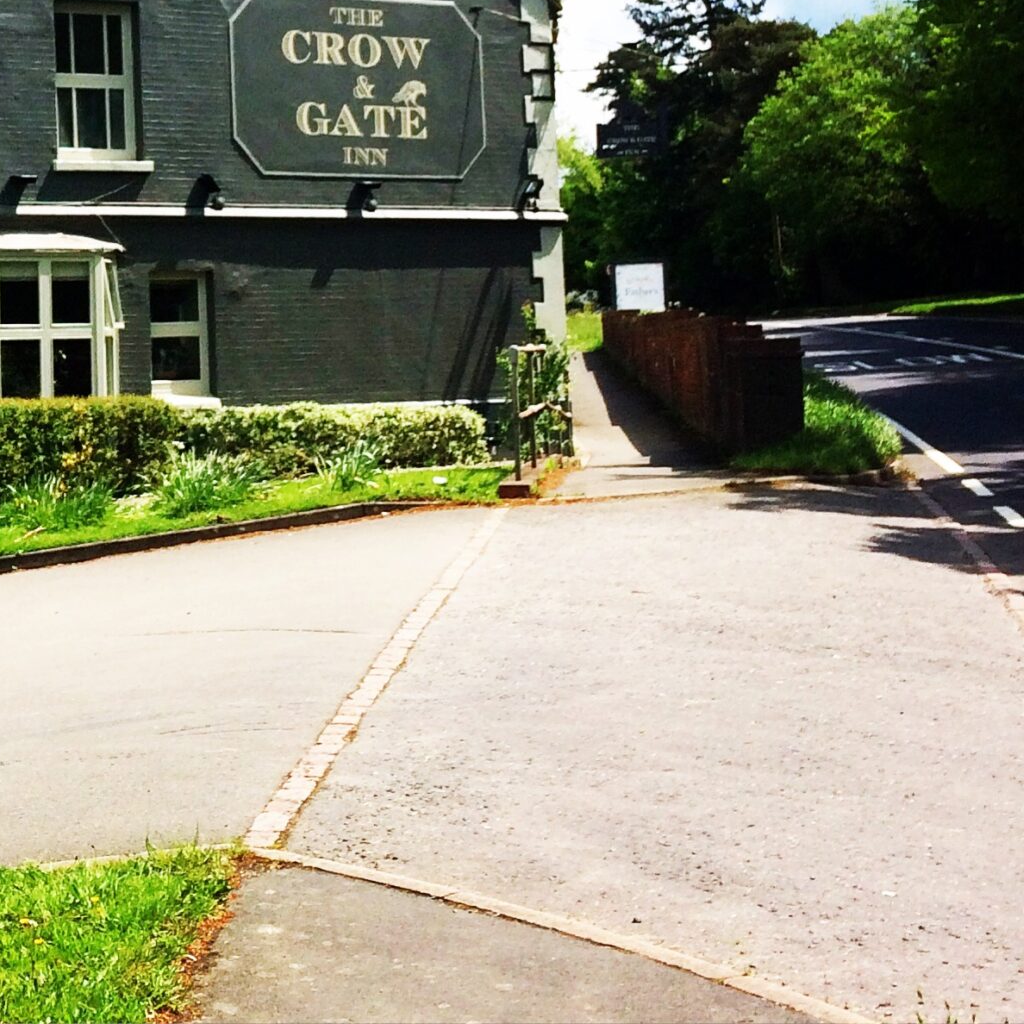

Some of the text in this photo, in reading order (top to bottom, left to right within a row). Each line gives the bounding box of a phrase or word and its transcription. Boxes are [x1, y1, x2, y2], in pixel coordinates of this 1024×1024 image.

[329, 6, 384, 27] THE
[281, 29, 431, 70] CROW
[352, 75, 375, 99] &
[295, 101, 428, 140] GATE
[343, 147, 388, 167] INN
